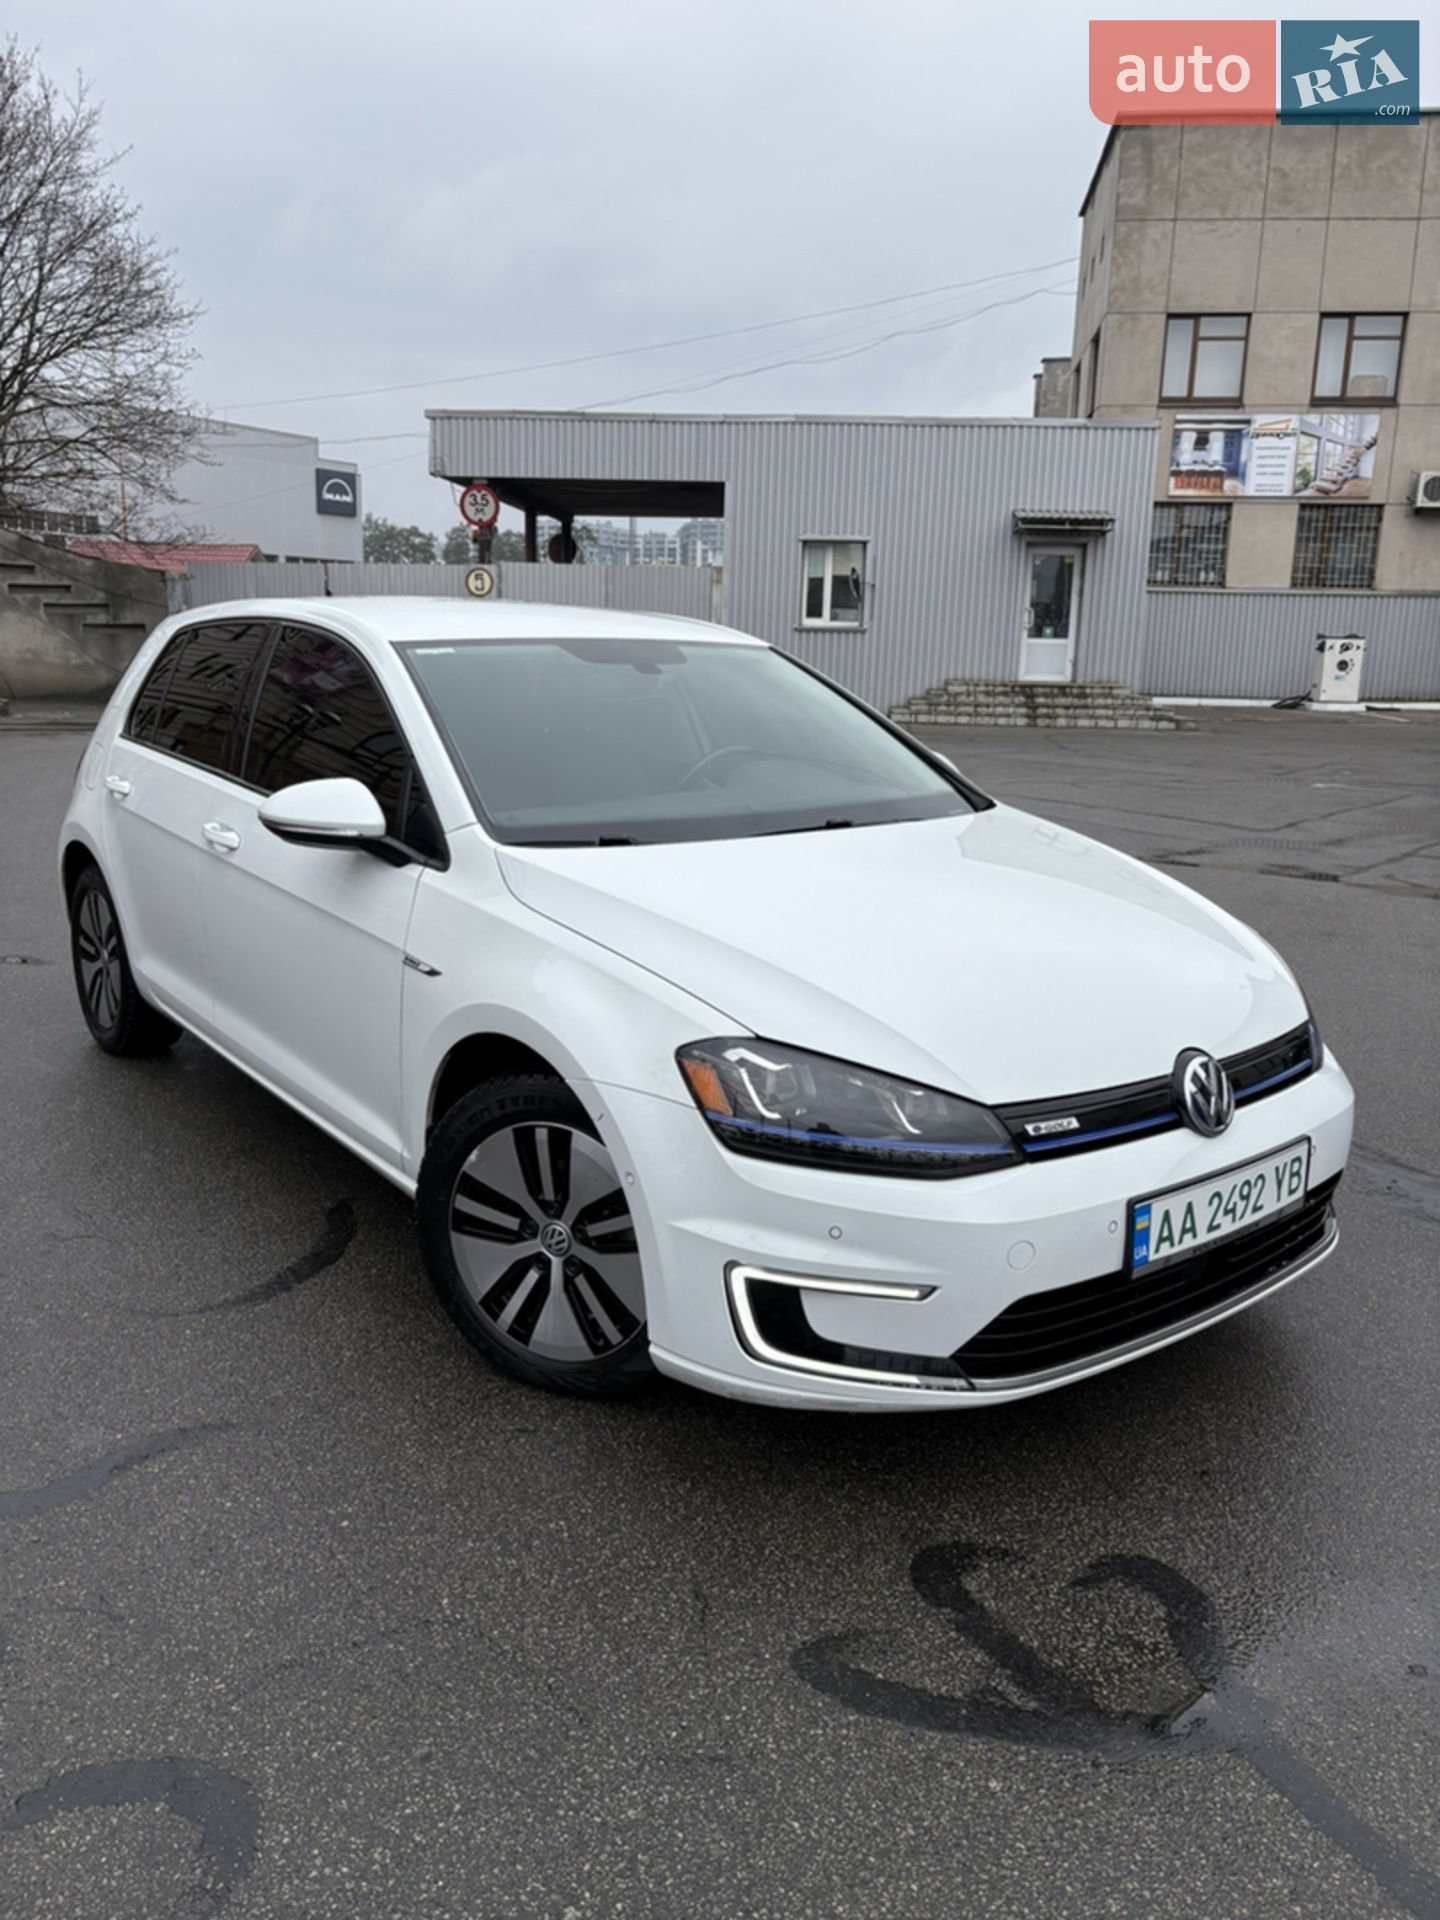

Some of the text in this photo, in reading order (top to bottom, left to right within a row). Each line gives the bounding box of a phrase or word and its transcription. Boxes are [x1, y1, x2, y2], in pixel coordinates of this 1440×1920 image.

[1154, 1201, 1198, 1254] AA
[1206, 1173, 1267, 1234] 2492
[1274, 1155, 1303, 1203] YB
